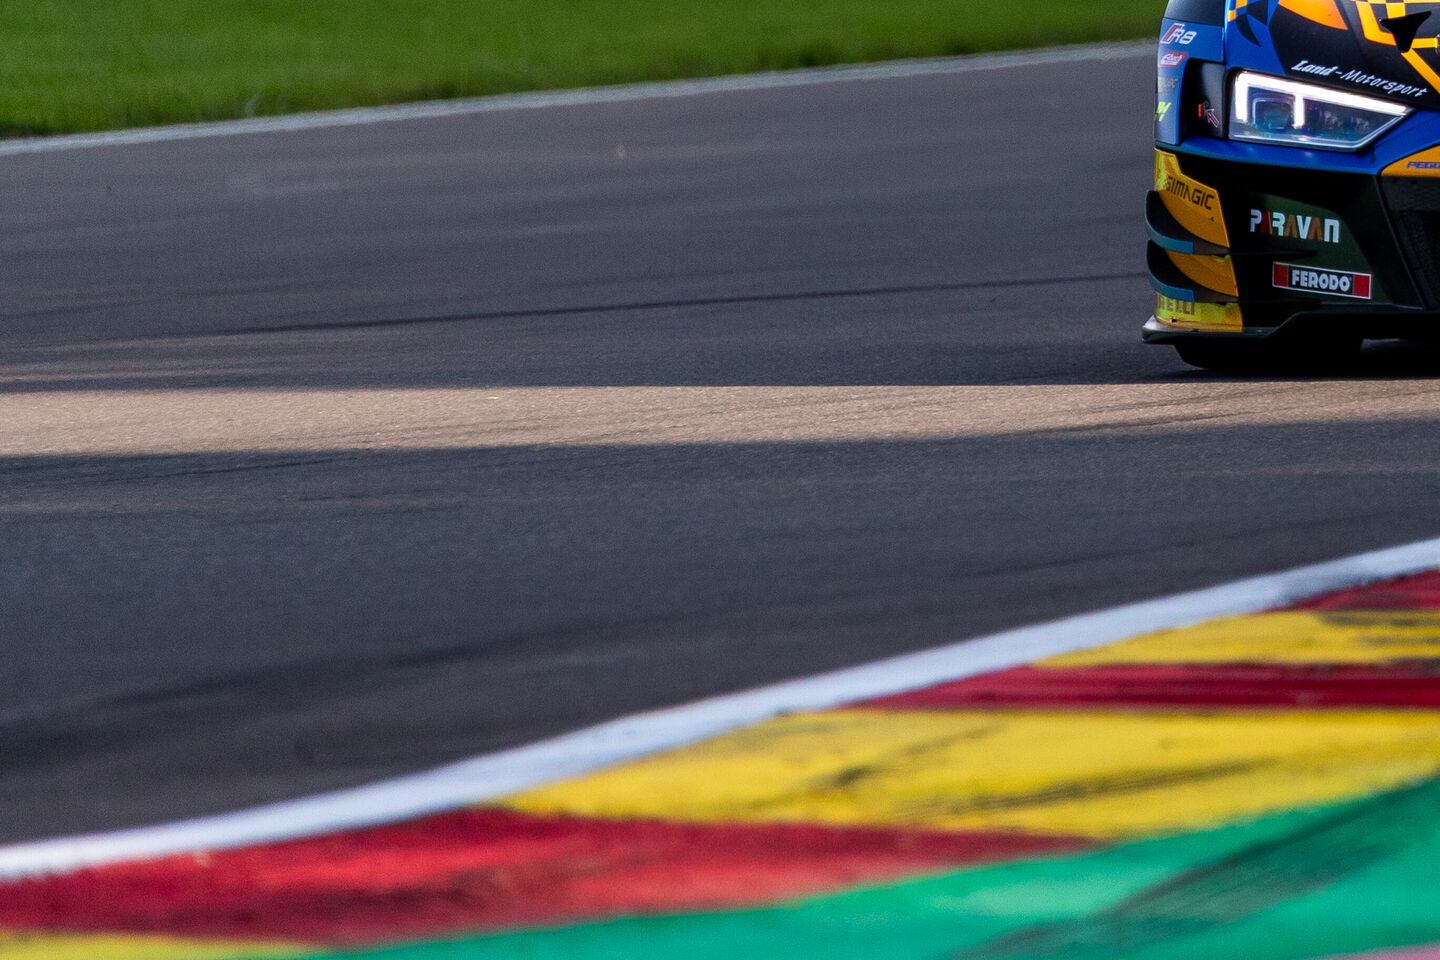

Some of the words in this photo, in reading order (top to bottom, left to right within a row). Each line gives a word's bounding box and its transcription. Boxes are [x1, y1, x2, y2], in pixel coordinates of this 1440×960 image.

[1165, 176, 1215, 210] SIMAGIC
[1250, 208, 1340, 243] PARAVAN
[1291, 268, 1351, 292] FERODO
